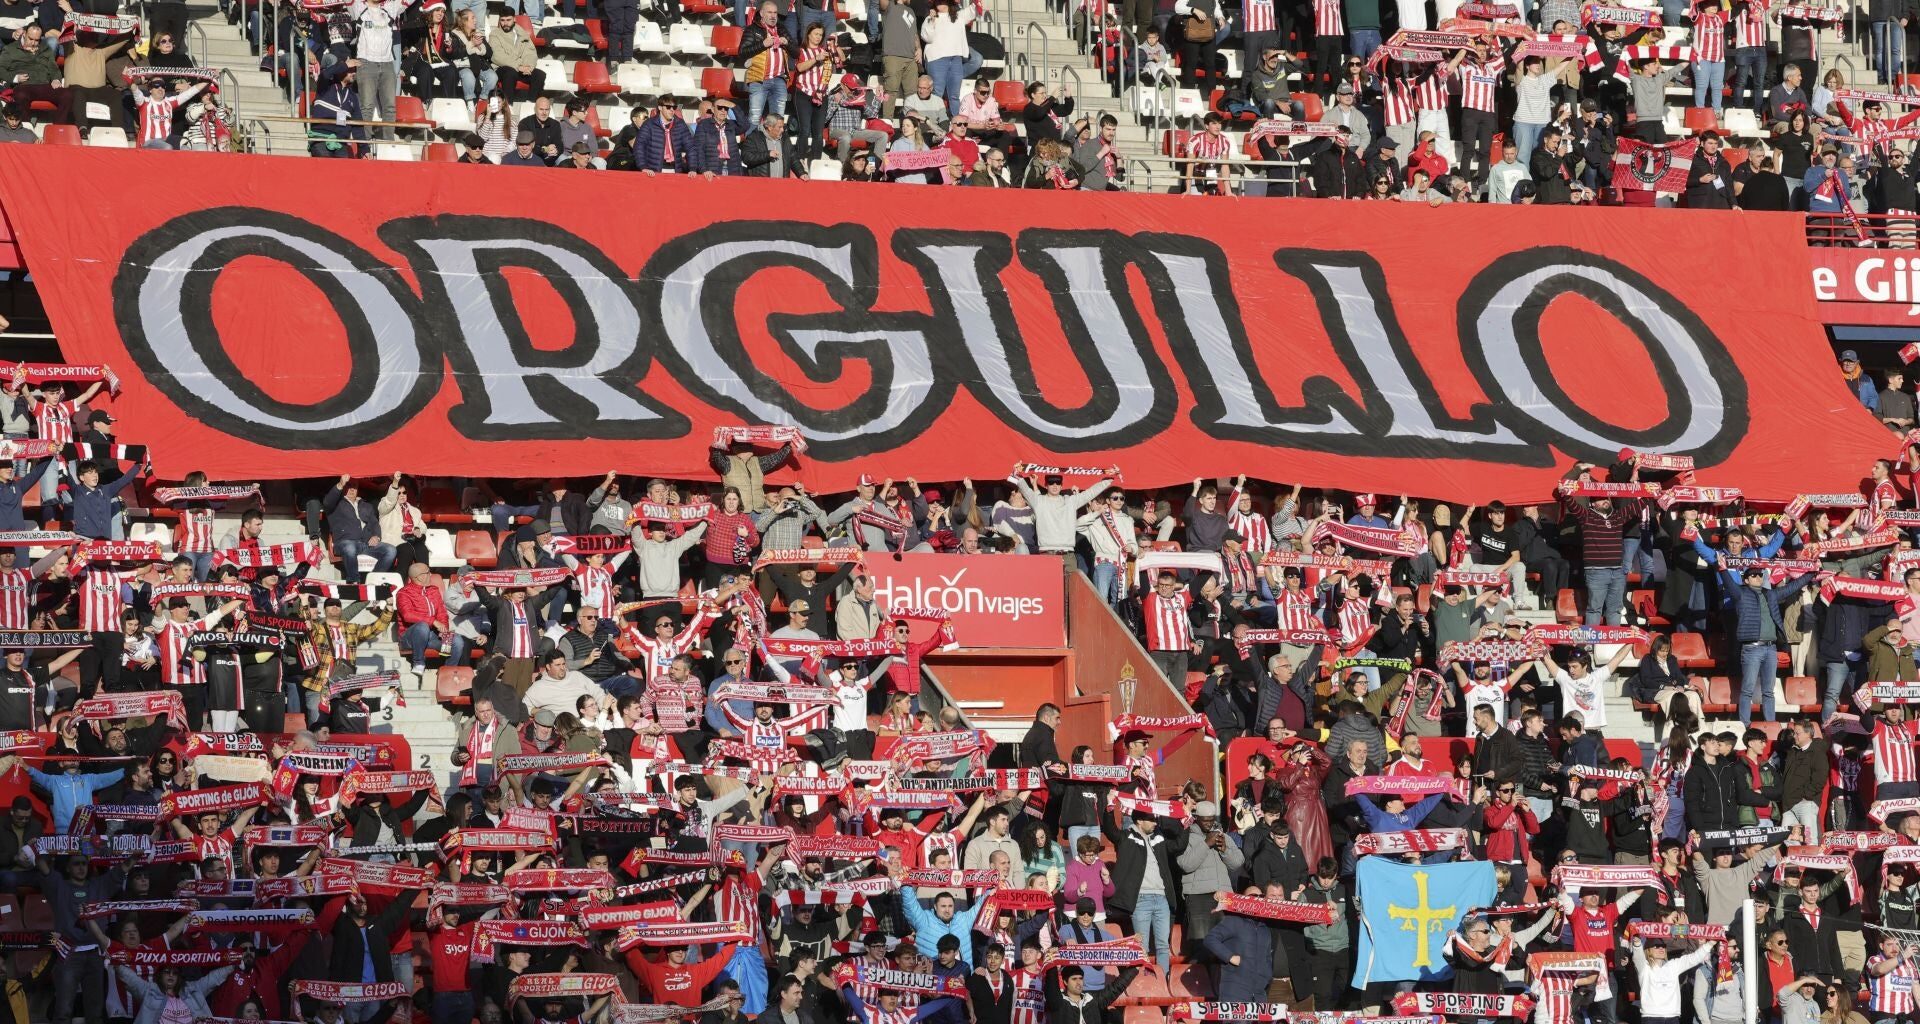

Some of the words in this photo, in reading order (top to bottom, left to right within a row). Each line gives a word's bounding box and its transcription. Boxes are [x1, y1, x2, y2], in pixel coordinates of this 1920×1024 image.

[1599, 7, 1642, 22] SPORTING
[1016, 25, 1024, 36] 6
[1050, 68, 1058, 79] 5
[1812, 267, 1838, 300] e
[113, 206, 1749, 468] ORGULLO
[28, 366, 46, 376] Real
[47, 366, 100, 377] SPORTING
[1024, 462, 1060, 475] Puxa
[1885, 510, 1902, 520] REAL
[102, 545, 154, 556] SPORTING
[232, 549, 255, 558] PUXA
[774, 549, 808, 560] GIJON
[1313, 555, 1343, 566] GIJON
[873, 567, 984, 614] Halcón
[984, 596, 1043, 621] viajes
[1836, 580, 1880, 595] SPORTING
[0, 633, 21, 645] RA
[43, 633, 80, 645] BOYS
[1541, 630, 1558, 640] Real
[1558, 629, 1597, 641] SPORTING
[1598, 630, 1607, 640] de
[844, 638, 895, 652] SPORTING
[1456, 642, 1527, 660] SPORTING
[1872, 684, 1891, 698] REAL
[382, 706, 394, 720] 3
[420, 754, 431, 768] 2
[1072, 764, 1100, 776] SIEMPRE
[1100, 765, 1129, 778] SPORTING
[365, 775, 387, 783] REAL
[777, 775, 814, 790] SPORTING
[816, 776, 825, 789] de
[900, 778, 924, 791] 101%
[1373, 775, 1446, 792] Sportinguista
[176, 791, 219, 809] SPORTING
[221, 792, 231, 803] de
[886, 792, 932, 804] SPORTING
[582, 820, 650, 833] SPORTING
[480, 833, 516, 846] SPORTING
[1705, 830, 1731, 841] SPORTING
[1735, 828, 1762, 838] MUJERES
[1729, 838, 1735, 846] IN
[1736, 836, 1750, 846] THAT
[1750, 834, 1768, 845] ORDER
[835, 849, 877, 858] ROJIBLANCA
[1565, 869, 1589, 879] REAL
[1603, 869, 1649, 880] SPORTING
[616, 868, 707, 898] SPORTING
[231, 913, 297, 925] SPORTING
[588, 910, 641, 924] SPORTING
[643, 905, 675, 919] GIJON
[529, 923, 566, 938] GIJÓN
[663, 926, 704, 936] SPORTING
[135, 952, 167, 963] PUXA
[170, 952, 221, 963] SPORTING
[1079, 950, 1114, 961] SPORTING
[1117, 949, 1139, 960] GIJON
[526, 977, 554, 986] REAL
[867, 967, 936, 989] SPORTING
[307, 982, 334, 992] REAL
[364, 981, 406, 997] GIJON
[1198, 1001, 1278, 1016] SPORTING
[1425, 993, 1505, 1012] SPORTING
